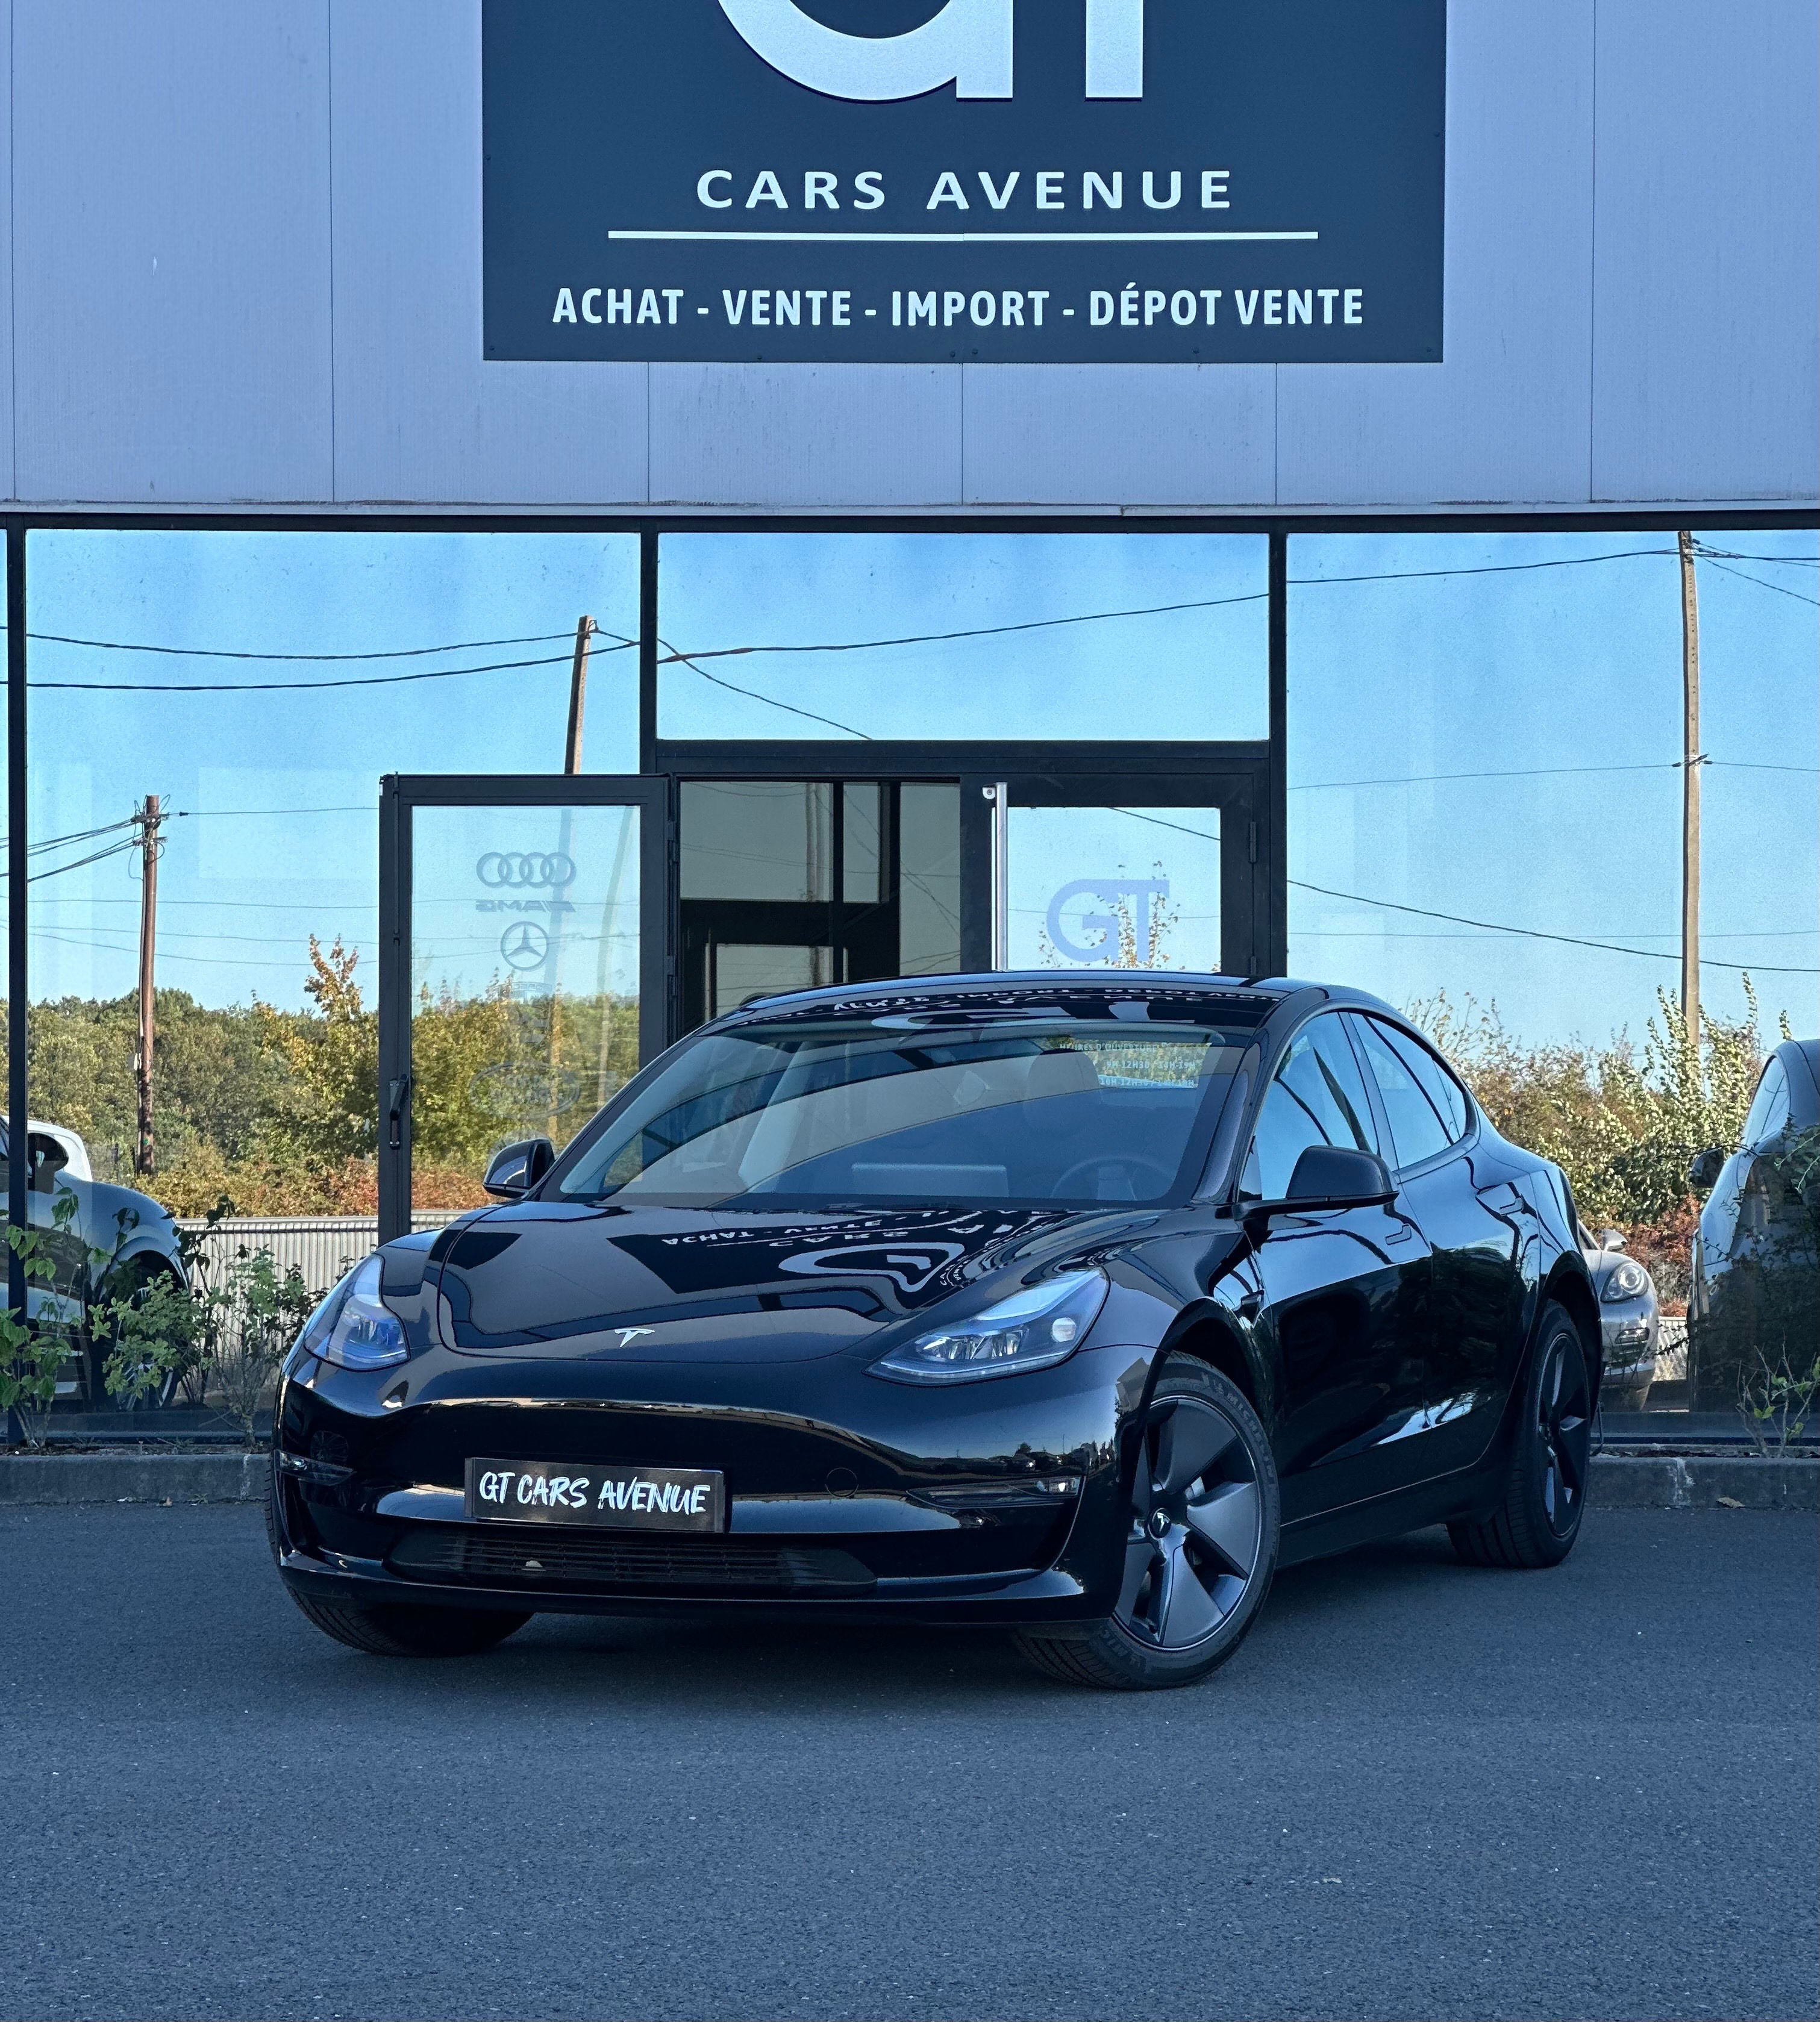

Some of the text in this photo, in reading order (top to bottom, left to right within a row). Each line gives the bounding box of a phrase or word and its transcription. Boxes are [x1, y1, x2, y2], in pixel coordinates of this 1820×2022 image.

[697, 170, 1231, 210] CARS AVENUE
[552, 287, 684, 324] ACHAT
[722, 289, 851, 326] VENTE
[892, 290, 1049, 326] IMPORT
[1090, 282, 1222, 326] DÉPOT
[1234, 289, 1363, 325] VENTE
[1047, 879, 1170, 963] GT
[479, 1471, 711, 1515] GT CARS AVENUE
